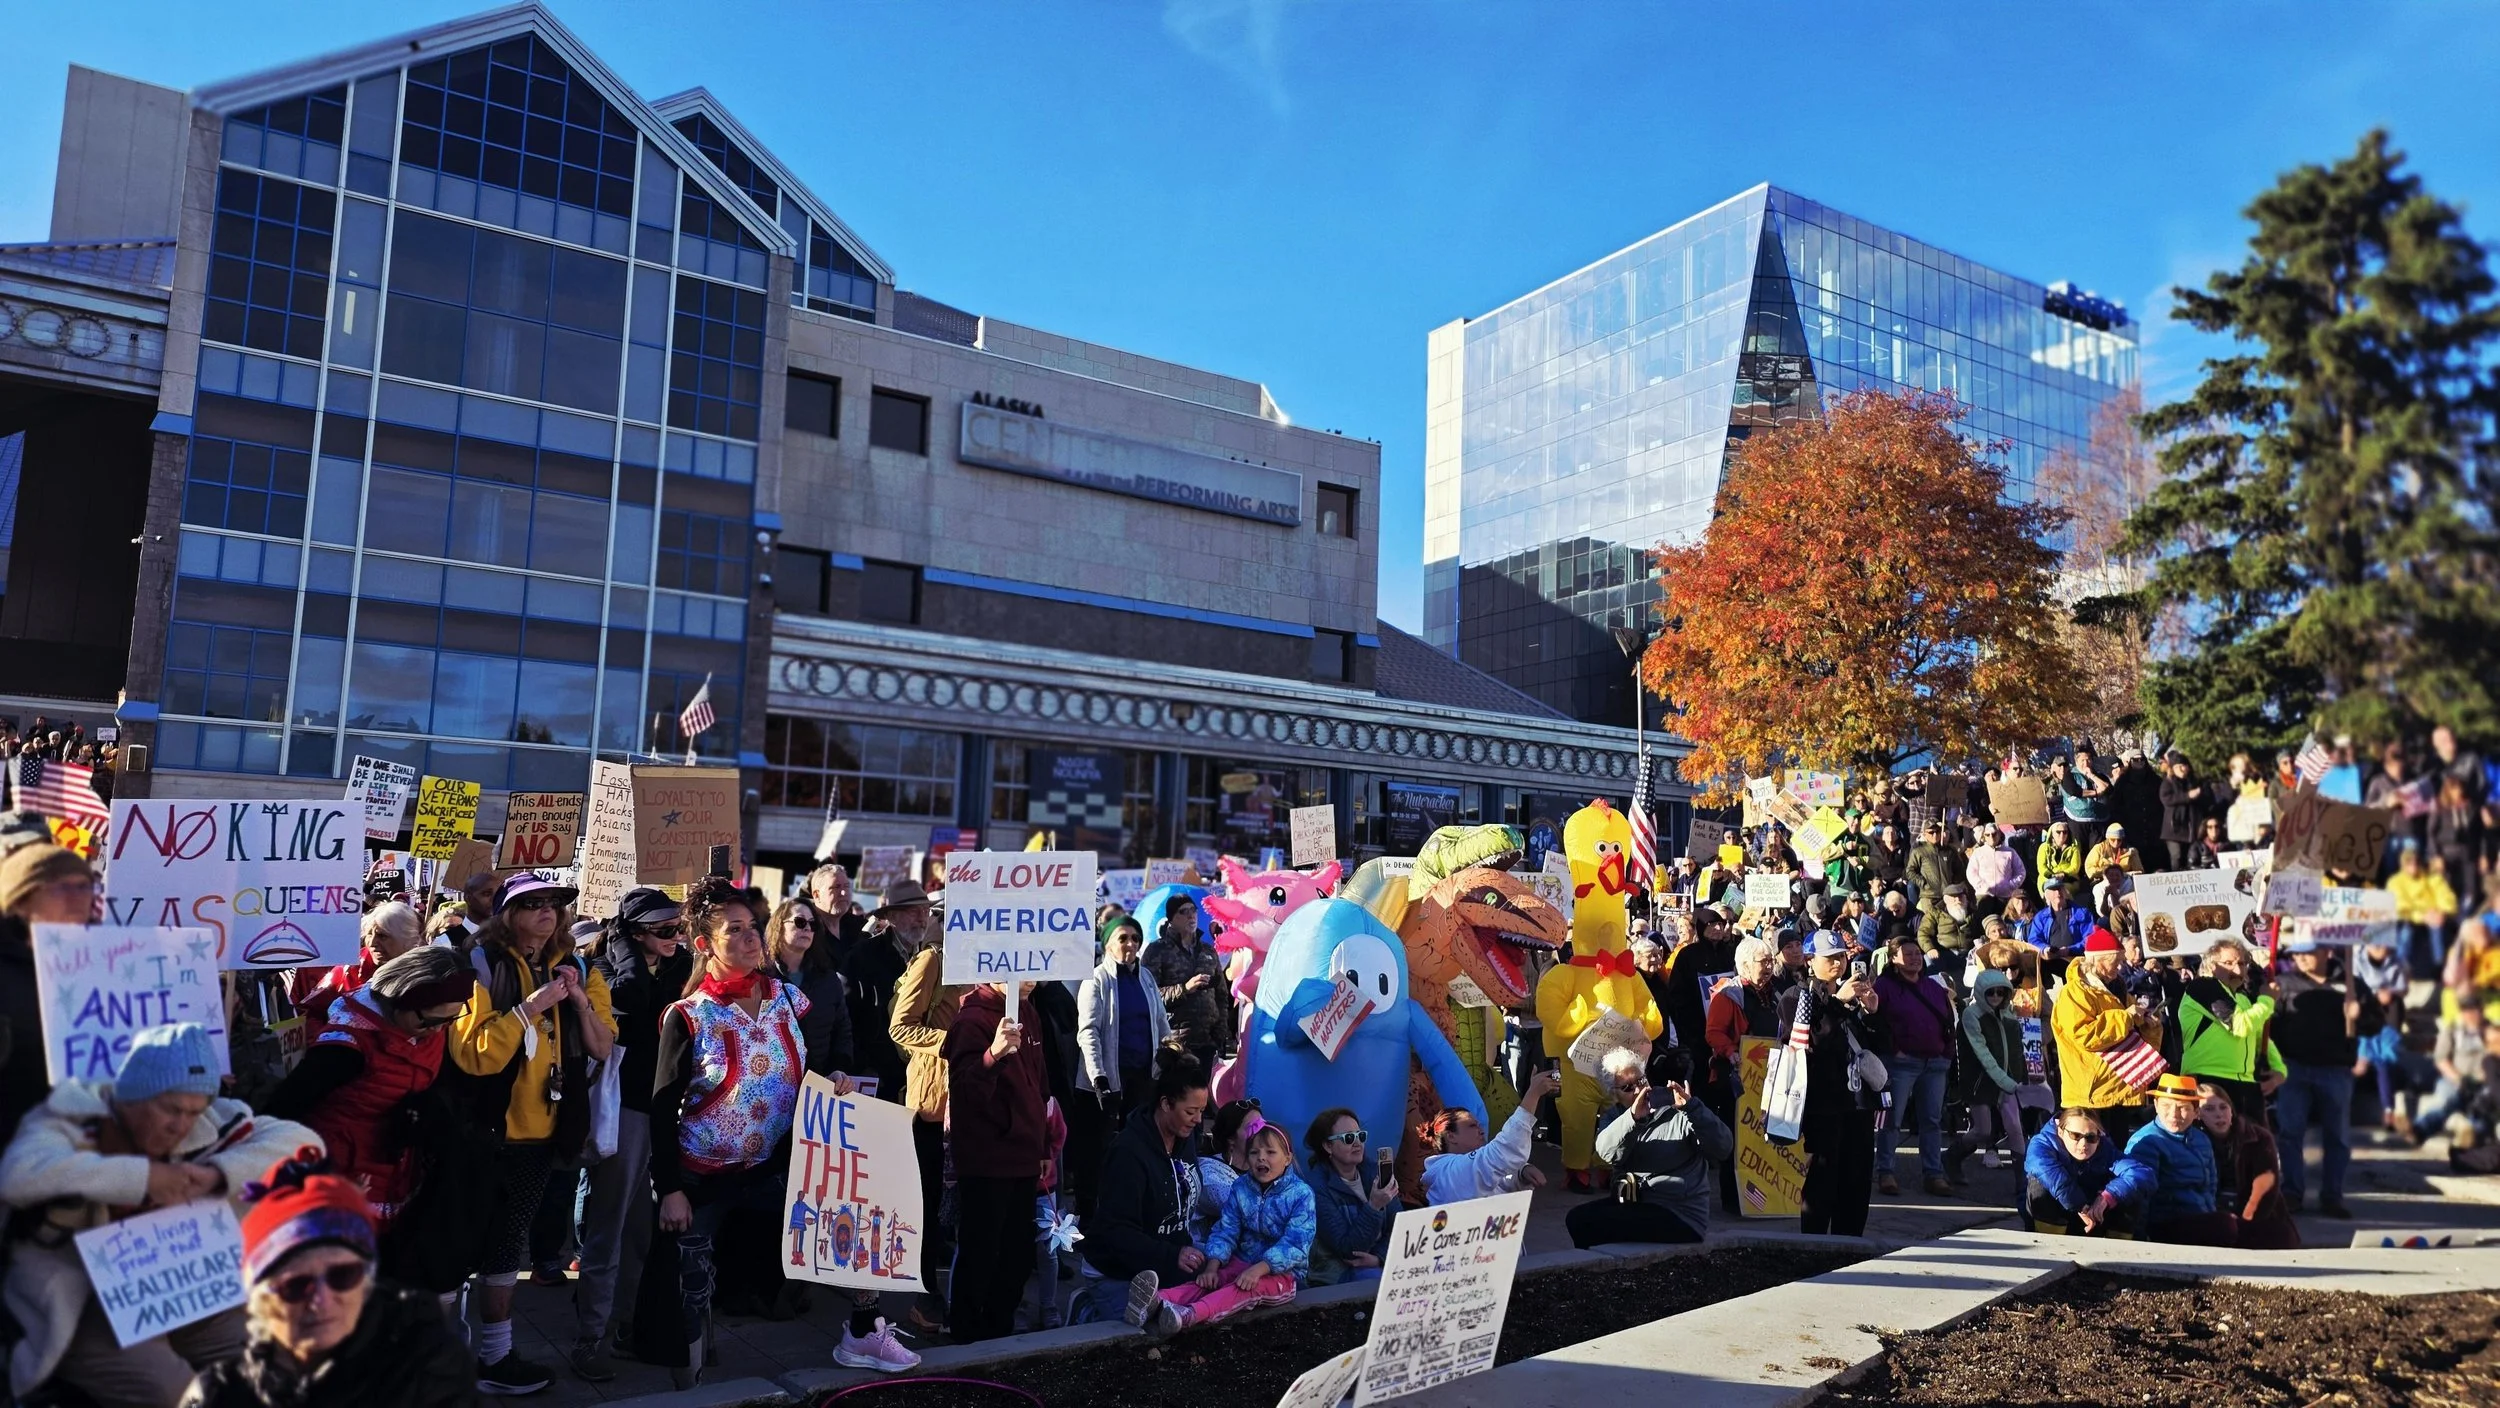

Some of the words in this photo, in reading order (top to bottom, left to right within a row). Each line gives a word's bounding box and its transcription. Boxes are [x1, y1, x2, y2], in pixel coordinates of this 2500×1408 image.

[972, 391, 1045, 418] ALASKA
[1135, 474, 1252, 510] PERFORMING
[1257, 500, 1299, 520] ARTS
[357, 756, 371, 768] NO
[373, 760, 390, 772] ONE
[392, 765, 414, 776] SHALL
[352, 779, 364, 788] OF
[355, 767, 369, 780] BE
[373, 770, 412, 786] DEPRIVED
[434, 778, 466, 794] OUR
[600, 766, 632, 788] Fasc
[422, 788, 479, 808] VETERANS
[512, 794, 535, 807] This
[555, 794, 582, 807] ends
[606, 788, 632, 802] HAT
[641, 788, 704, 806] LOYALTY
[709, 790, 726, 806] TO
[1405, 791, 1455, 811] Nutcracker
[508, 810, 537, 821] when
[542, 809, 579, 823] enough
[594, 800, 633, 818] Blacks
[682, 810, 713, 825] OUR
[226, 802, 345, 861] KING
[515, 822, 529, 834] of
[552, 823, 571, 837] say
[593, 814, 632, 832] Asians
[365, 827, 395, 840] PROCESS!
[432, 838, 458, 847] NOT
[591, 830, 619, 844] Jews
[648, 828, 738, 845] CONSTITUTION
[413, 844, 453, 860] Fascis
[511, 834, 560, 865] NO
[644, 850, 674, 868] NOT
[685, 852, 695, 867] A
[948, 859, 981, 883] the
[993, 864, 1072, 889] LOVE
[1394, 861, 1415, 869] DEMOC
[536, 870, 560, 882] YOU
[587, 872, 623, 888] Unions
[2149, 873, 2201, 887] BEAGLES
[583, 886, 611, 902] Asylum
[2166, 883, 2218, 896] AGAINST
[233, 886, 361, 916] QUEENS
[947, 907, 1091, 933] AMERICA
[978, 950, 1055, 973] RALLY
[147, 955, 203, 989] I'm
[73, 986, 190, 1029] ANTI-
[1321, 990, 1356, 1047] MATTERS
[1589, 1028, 1618, 1041] MING
[1574, 1050, 1594, 1064] THE
[803, 1085, 859, 1151] WE
[1741, 1106, 1767, 1137] DUE
[1773, 1143, 1809, 1178] ROCESS
[799, 1138, 869, 1205] THE
[1740, 1146, 1802, 1206] EDUCATIO
[1482, 1212, 1520, 1243] PEACE
[106, 1229, 148, 1263] I'm
[153, 1218, 199, 1243] living
[118, 1248, 160, 1279] proof
[101, 1243, 242, 1313] HEALTHCARE
[134, 1276, 242, 1335] MATTERS
